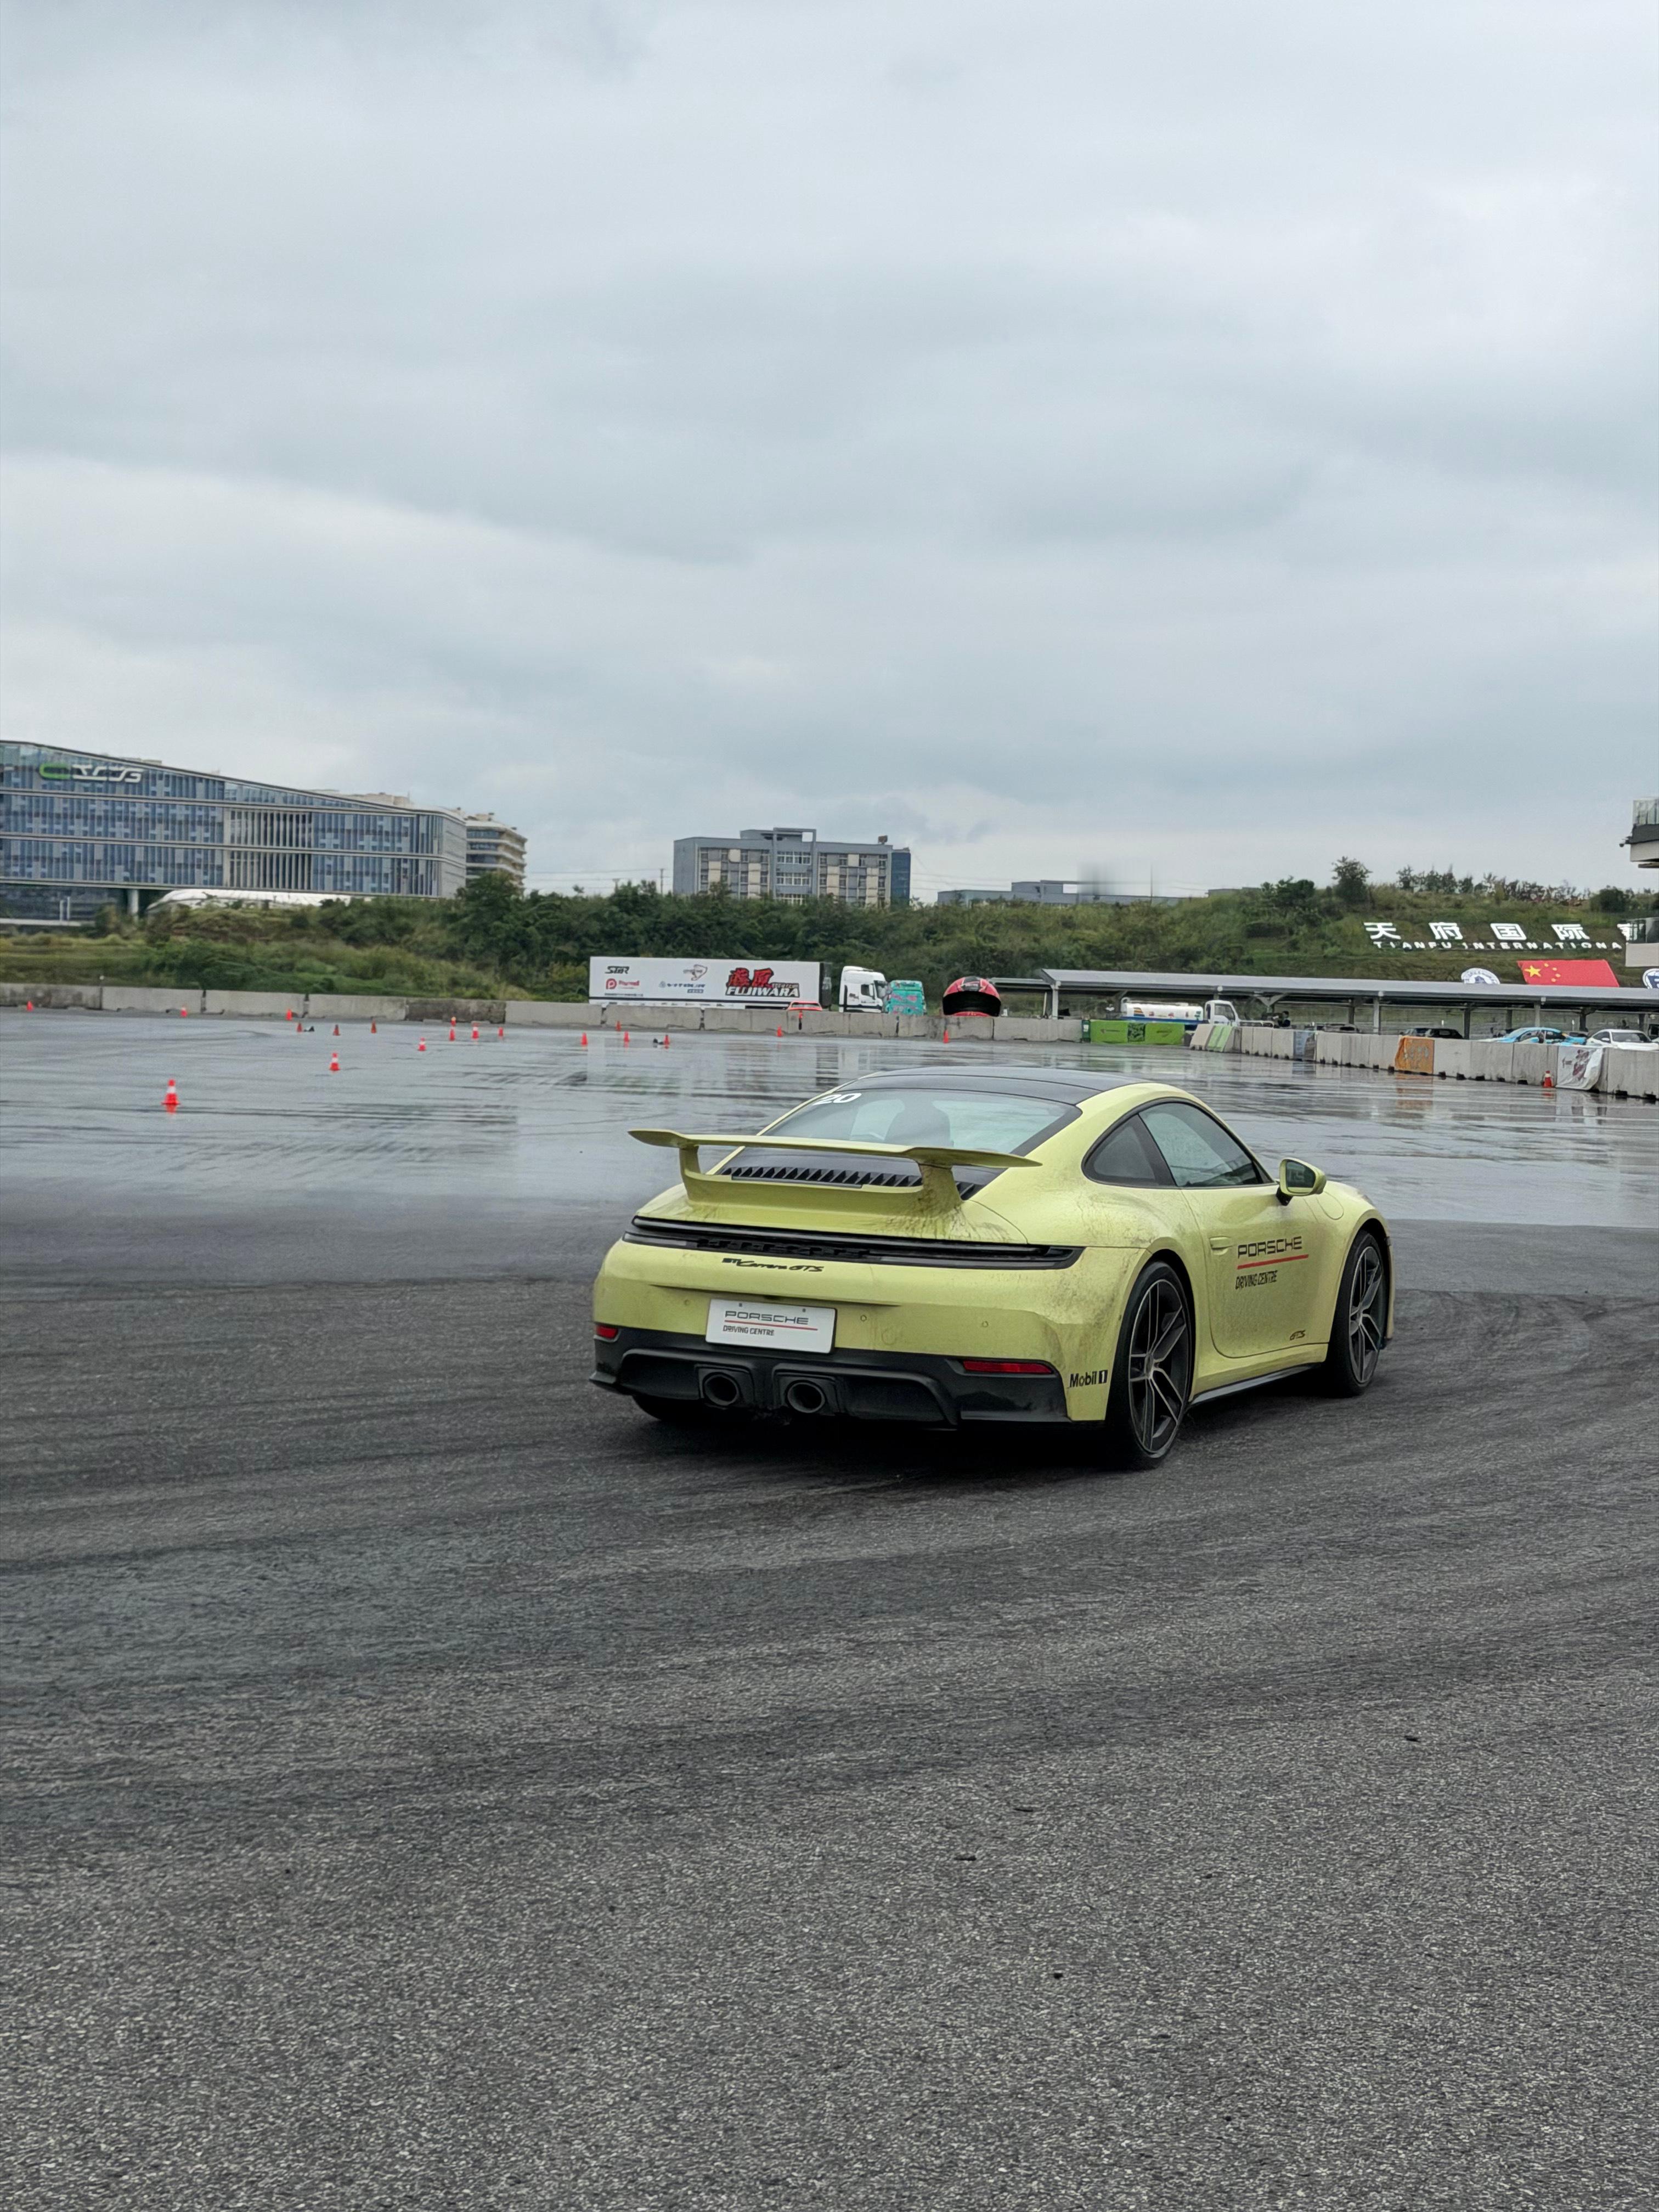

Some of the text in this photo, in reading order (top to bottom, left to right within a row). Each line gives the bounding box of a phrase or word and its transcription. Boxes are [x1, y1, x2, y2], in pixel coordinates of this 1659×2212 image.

[1373, 941, 1629, 950] TIANFU INTERNATIONA
[725, 986, 799, 997] FUJIWARA
[1238, 1235, 1302, 1259] PORSCHE
[736, 1261, 787, 1270] Carrera
[724, 1310, 809, 1325] PORSCHE
[723, 1325, 775, 1336] DRIVING CENTRE
[1069, 1371, 1098, 1387] Mobil
